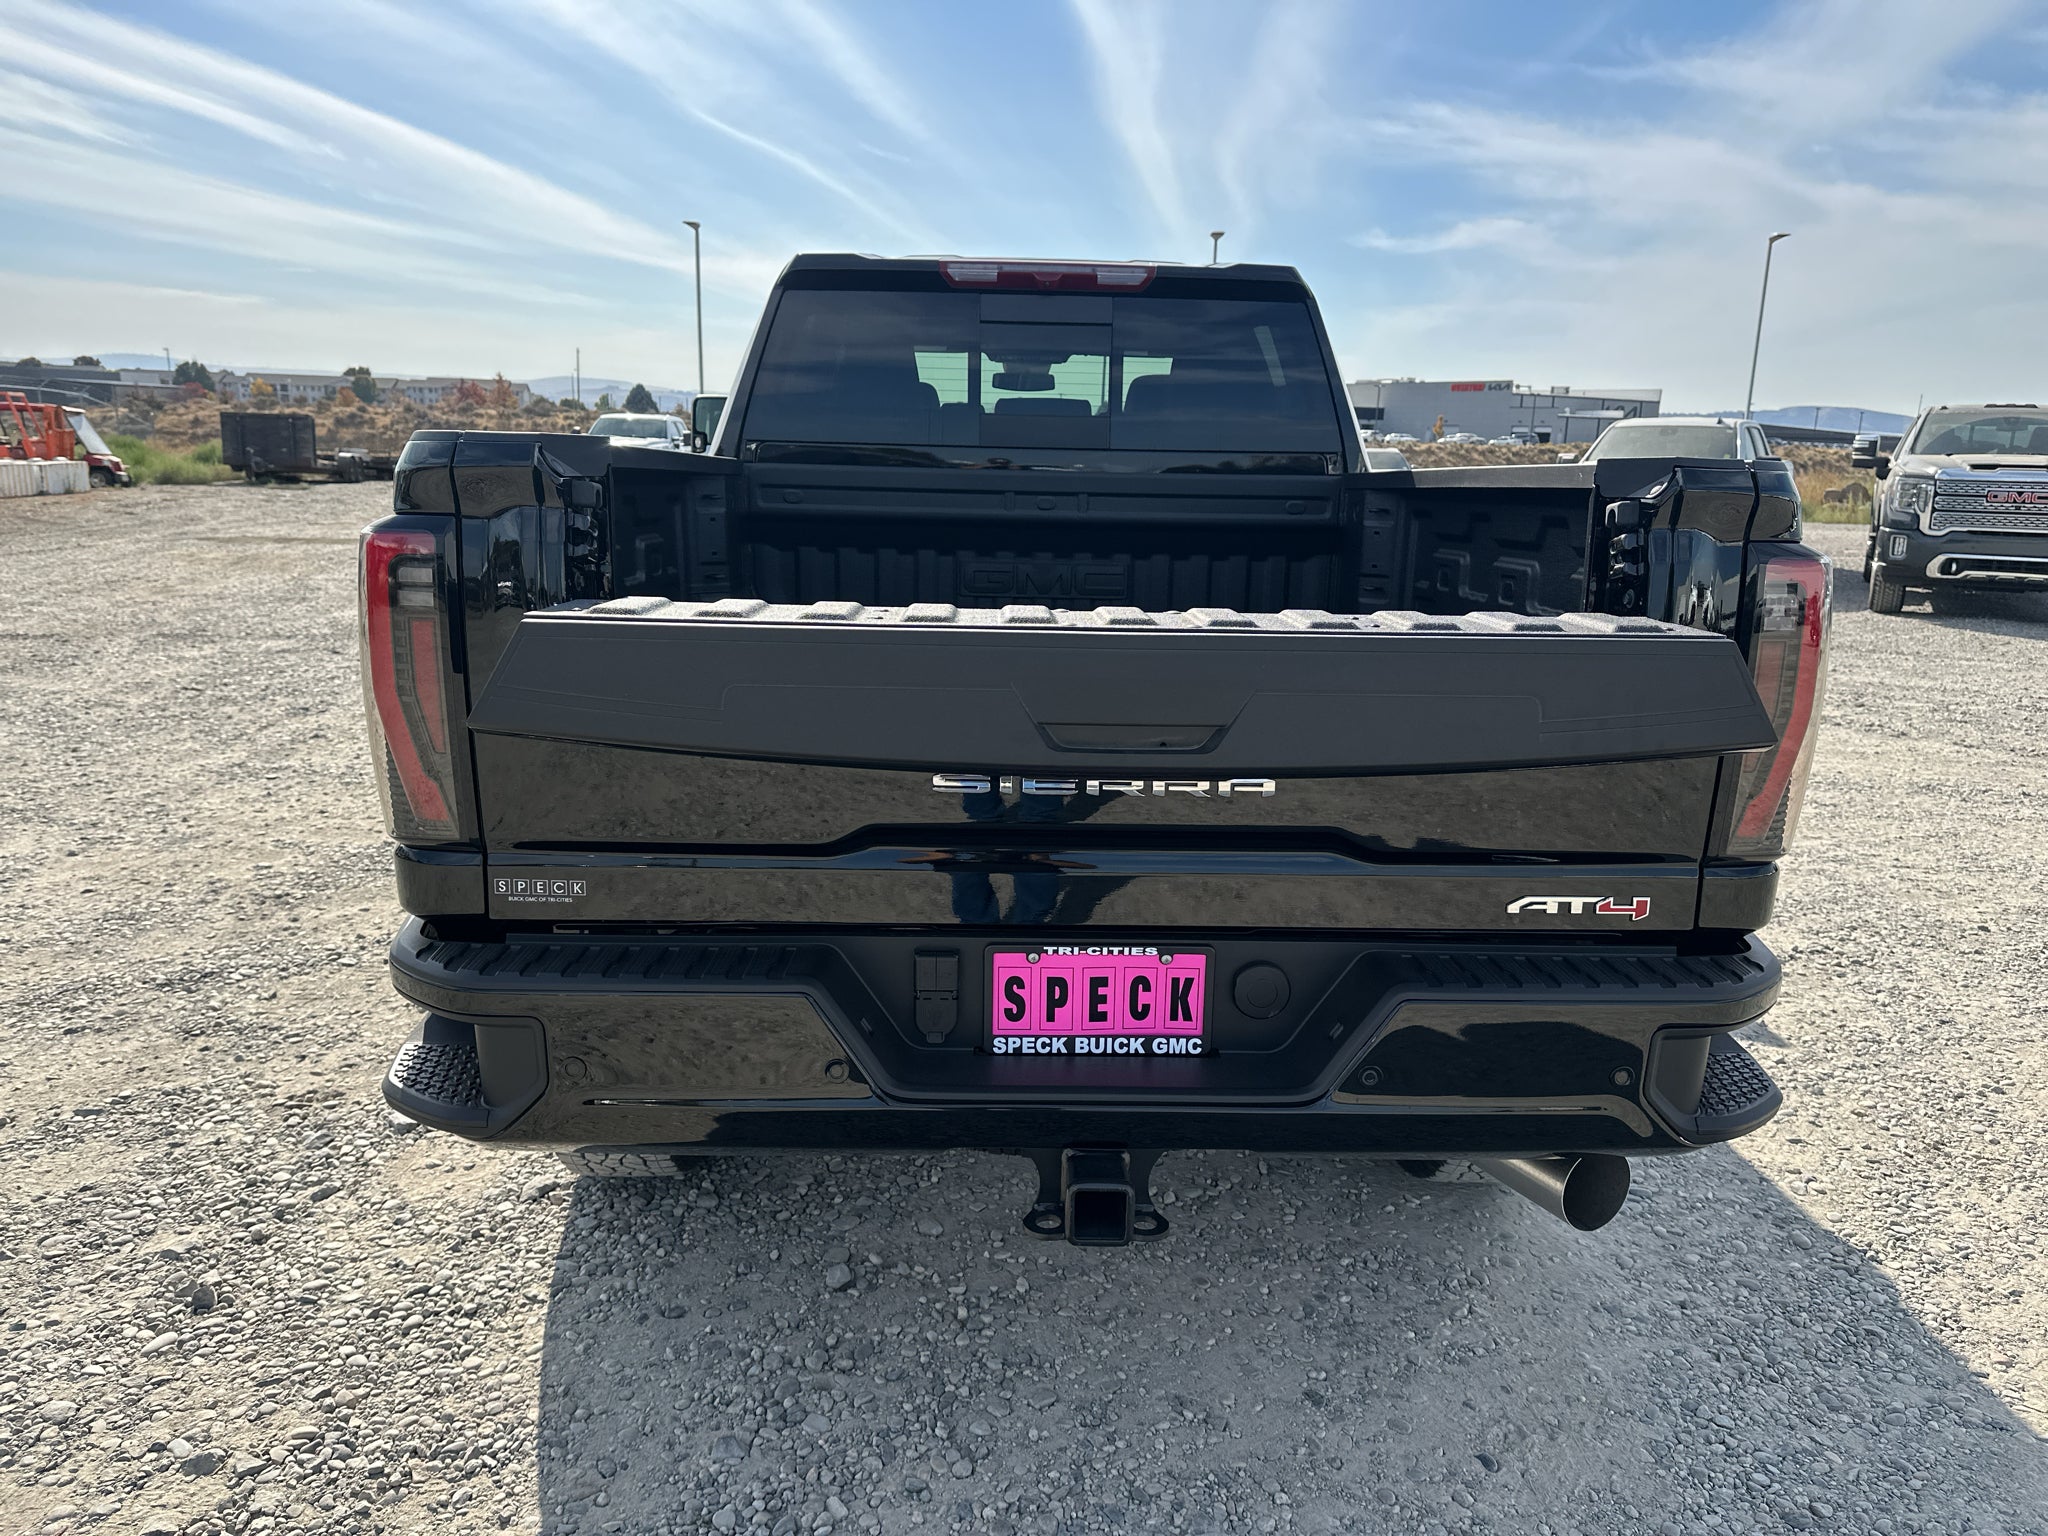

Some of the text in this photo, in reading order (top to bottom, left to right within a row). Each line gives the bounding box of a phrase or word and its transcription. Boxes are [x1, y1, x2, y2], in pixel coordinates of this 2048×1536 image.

[1986, 491, 2048, 504] GMC
[963, 564, 1126, 596] GMC
[932, 773, 1277, 798] SIERRA
[497, 880, 584, 895] SPECK
[1507, 896, 1650, 921] AT4
[1043, 946, 1158, 956] TRI-CITIES
[1003, 975, 1195, 1023] SPECK
[992, 1037, 1203, 1054] SPECK BUICK GMC
